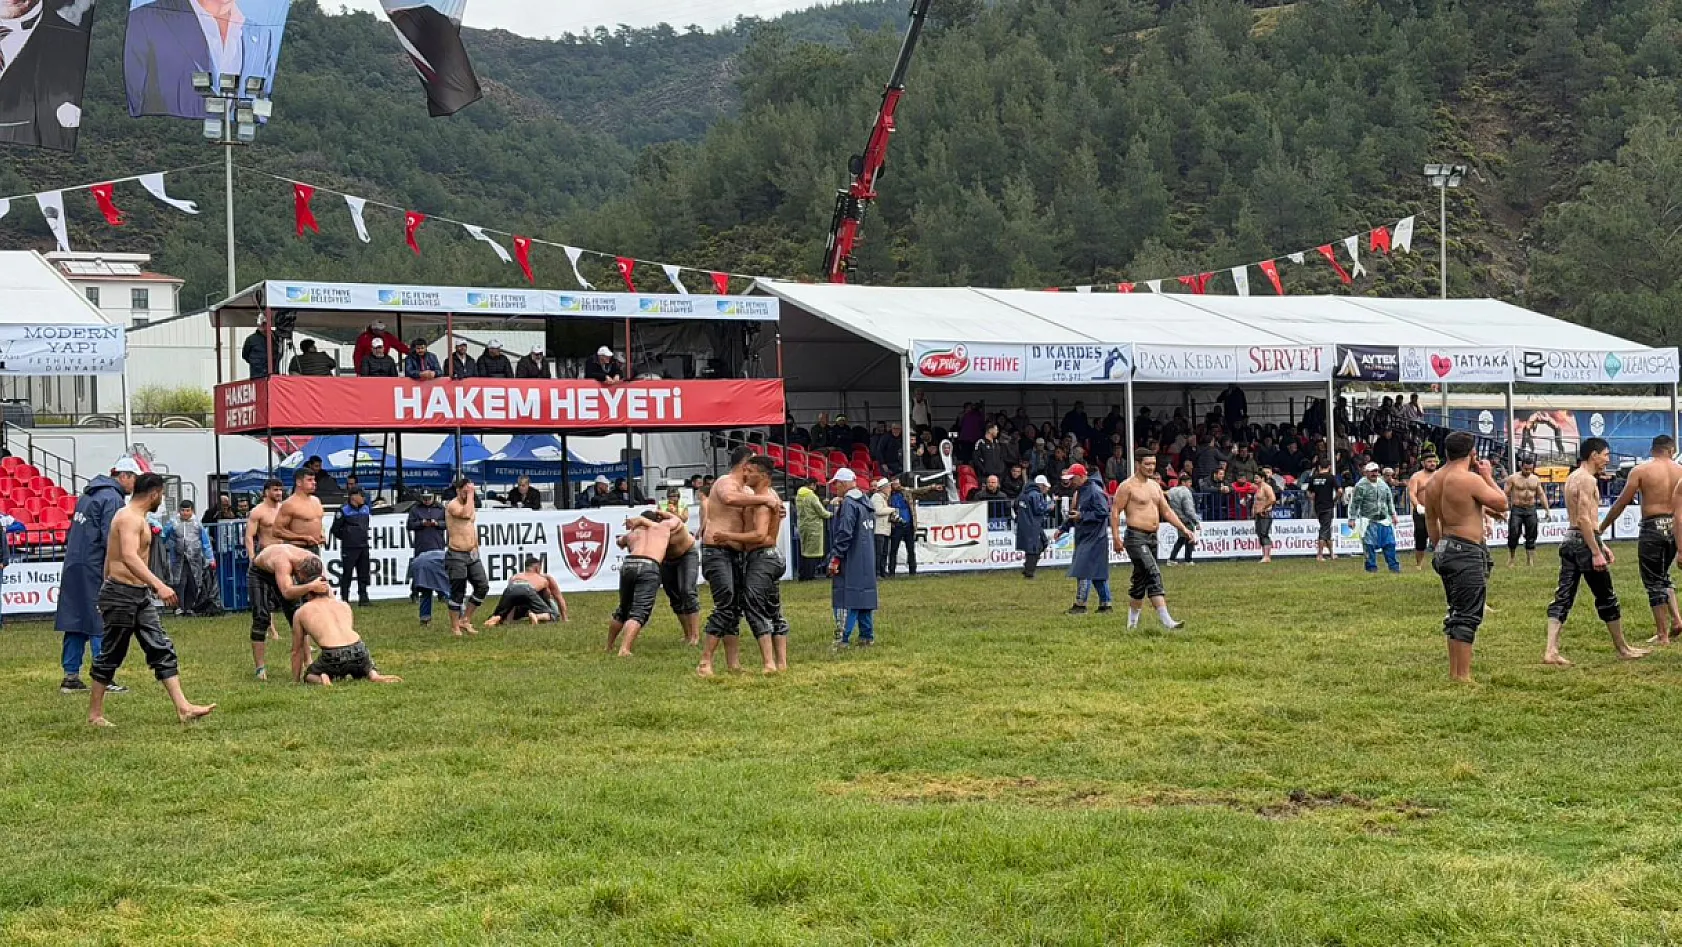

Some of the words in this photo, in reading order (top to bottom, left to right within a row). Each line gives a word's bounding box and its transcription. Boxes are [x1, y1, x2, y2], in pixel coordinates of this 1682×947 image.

[24, 326, 119, 339] MODERN
[46, 341, 98, 353] YAPI
[1032, 346, 1041, 359] D
[1046, 345, 1102, 363] KARDEŞ
[973, 353, 1019, 372] FETHİYE
[1054, 359, 1081, 371] PEN
[1140, 351, 1178, 373] PAŞA
[1184, 351, 1232, 370] KEBAP
[1249, 346, 1322, 374] SERVET
[1362, 354, 1397, 365] AYTEK
[1453, 354, 1509, 368] TATYAKA
[1547, 351, 1598, 369] ORKA
[1553, 369, 1592, 379] HOMES
[224, 383, 256, 407] HAKEM
[394, 386, 540, 419] HAKEM
[27, 570, 61, 584] Must
[2, 590, 41, 606] van
